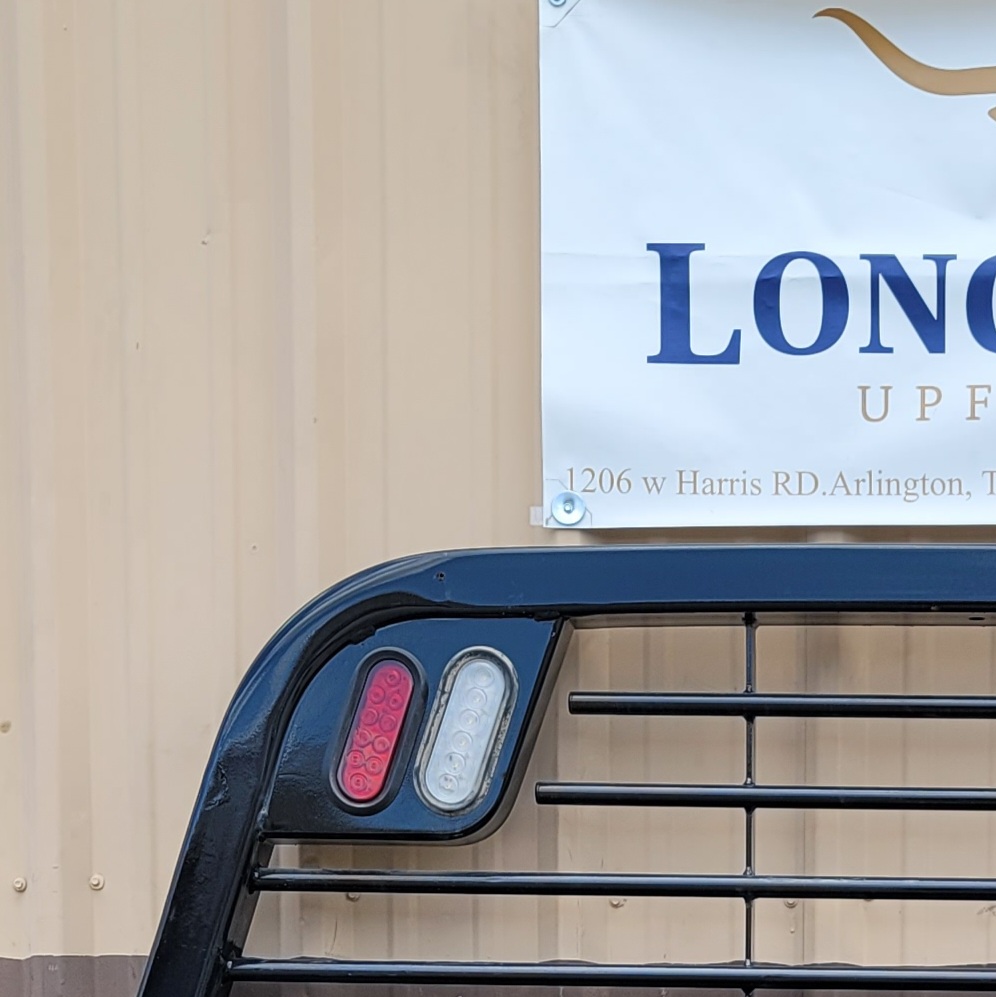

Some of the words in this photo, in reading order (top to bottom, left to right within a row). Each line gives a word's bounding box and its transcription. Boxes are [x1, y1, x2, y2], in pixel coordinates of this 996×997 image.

[566, 466, 633, 495] 1206
[640, 475, 668, 496] w
[675, 468, 763, 497] Harris
